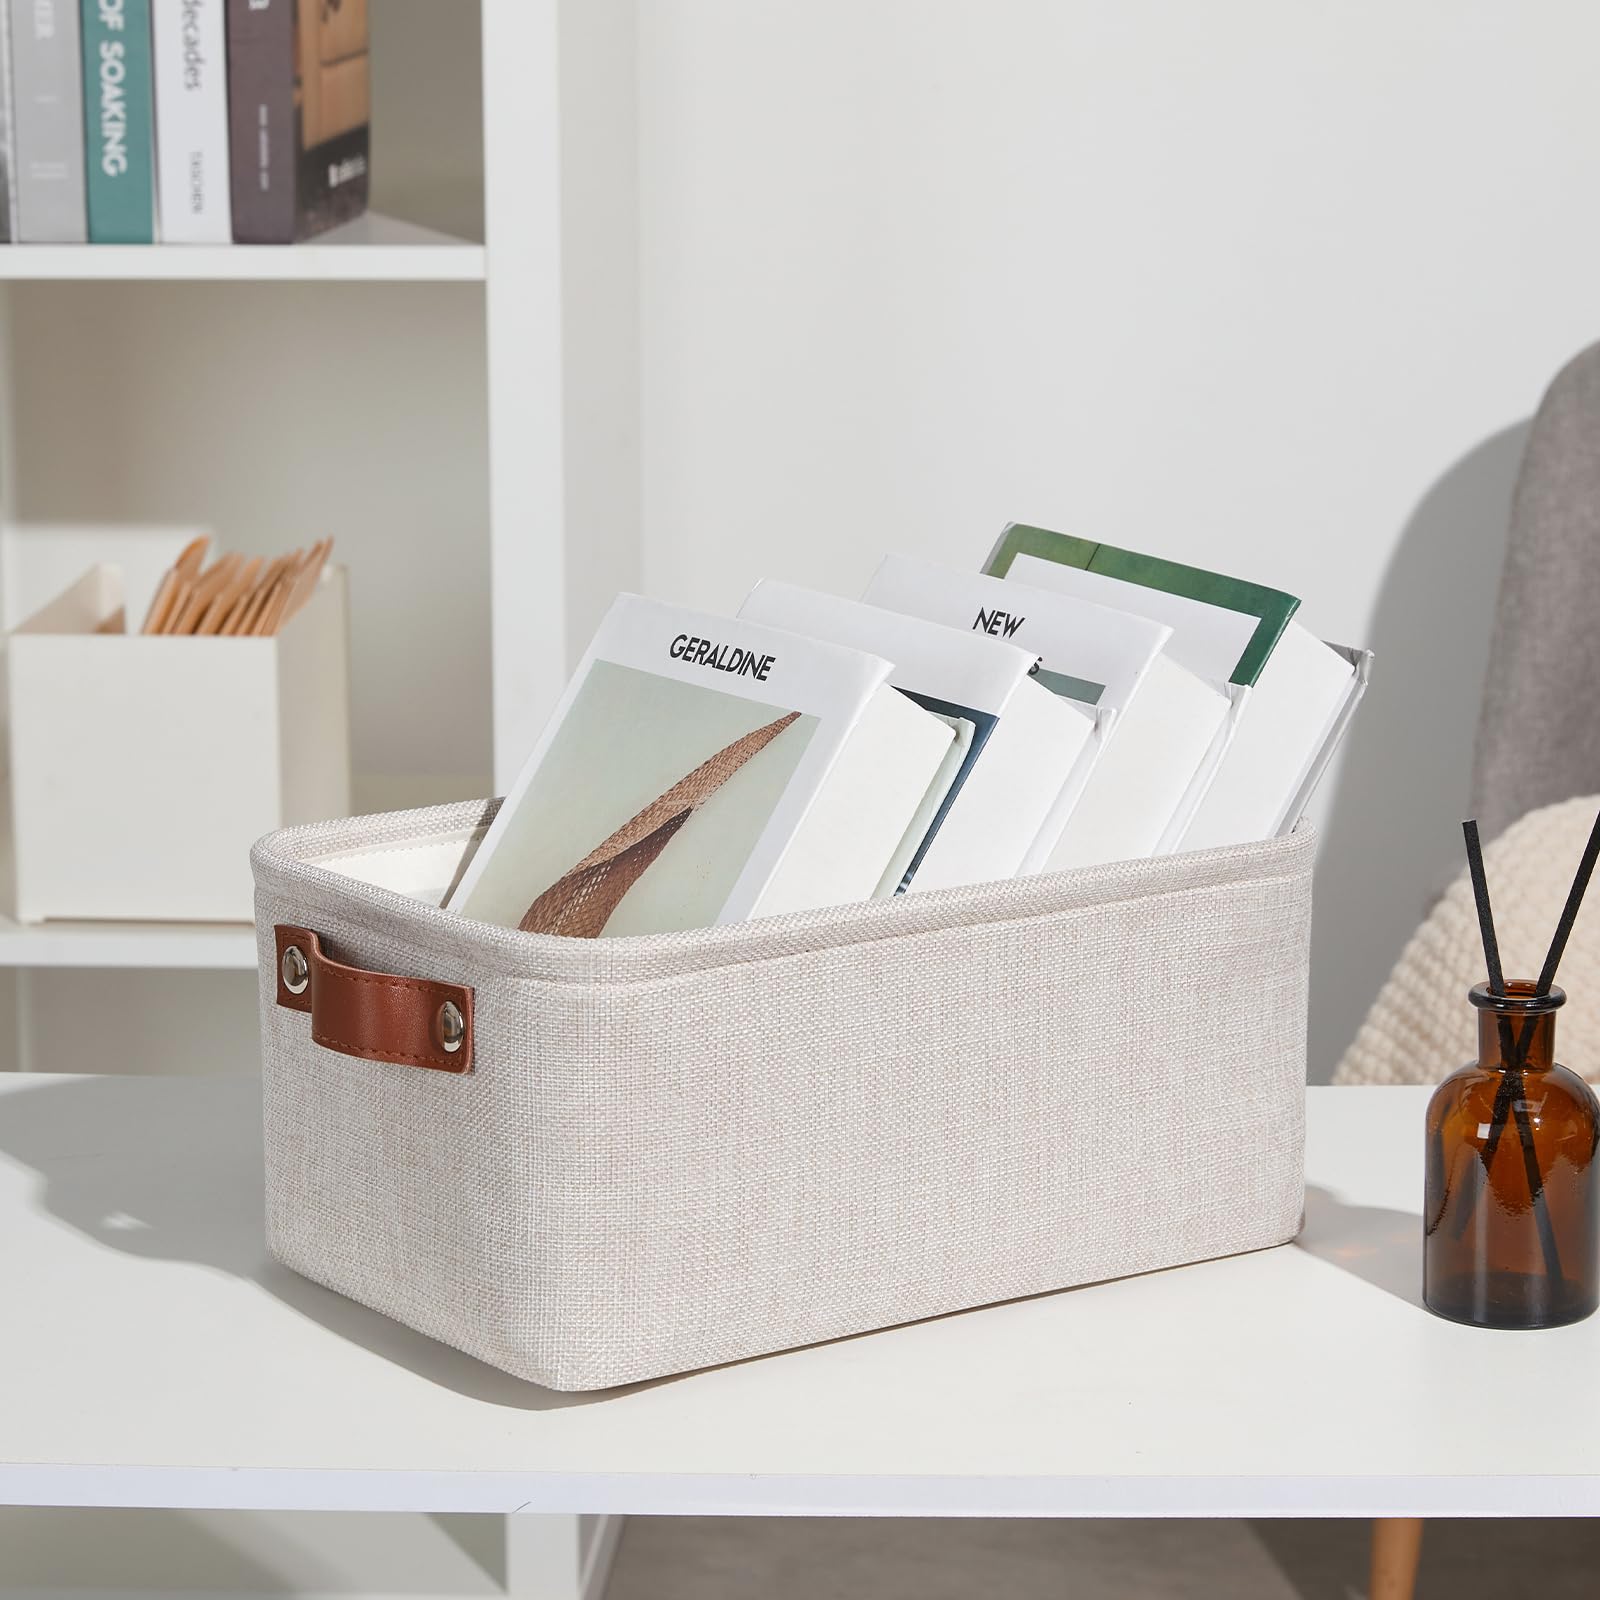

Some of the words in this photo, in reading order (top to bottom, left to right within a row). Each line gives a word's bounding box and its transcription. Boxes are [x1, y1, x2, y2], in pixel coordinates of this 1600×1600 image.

[100, 41, 128, 176] SOAKING
[973, 607, 1026, 639] NEW
[670, 634, 776, 682] GERALDINE
